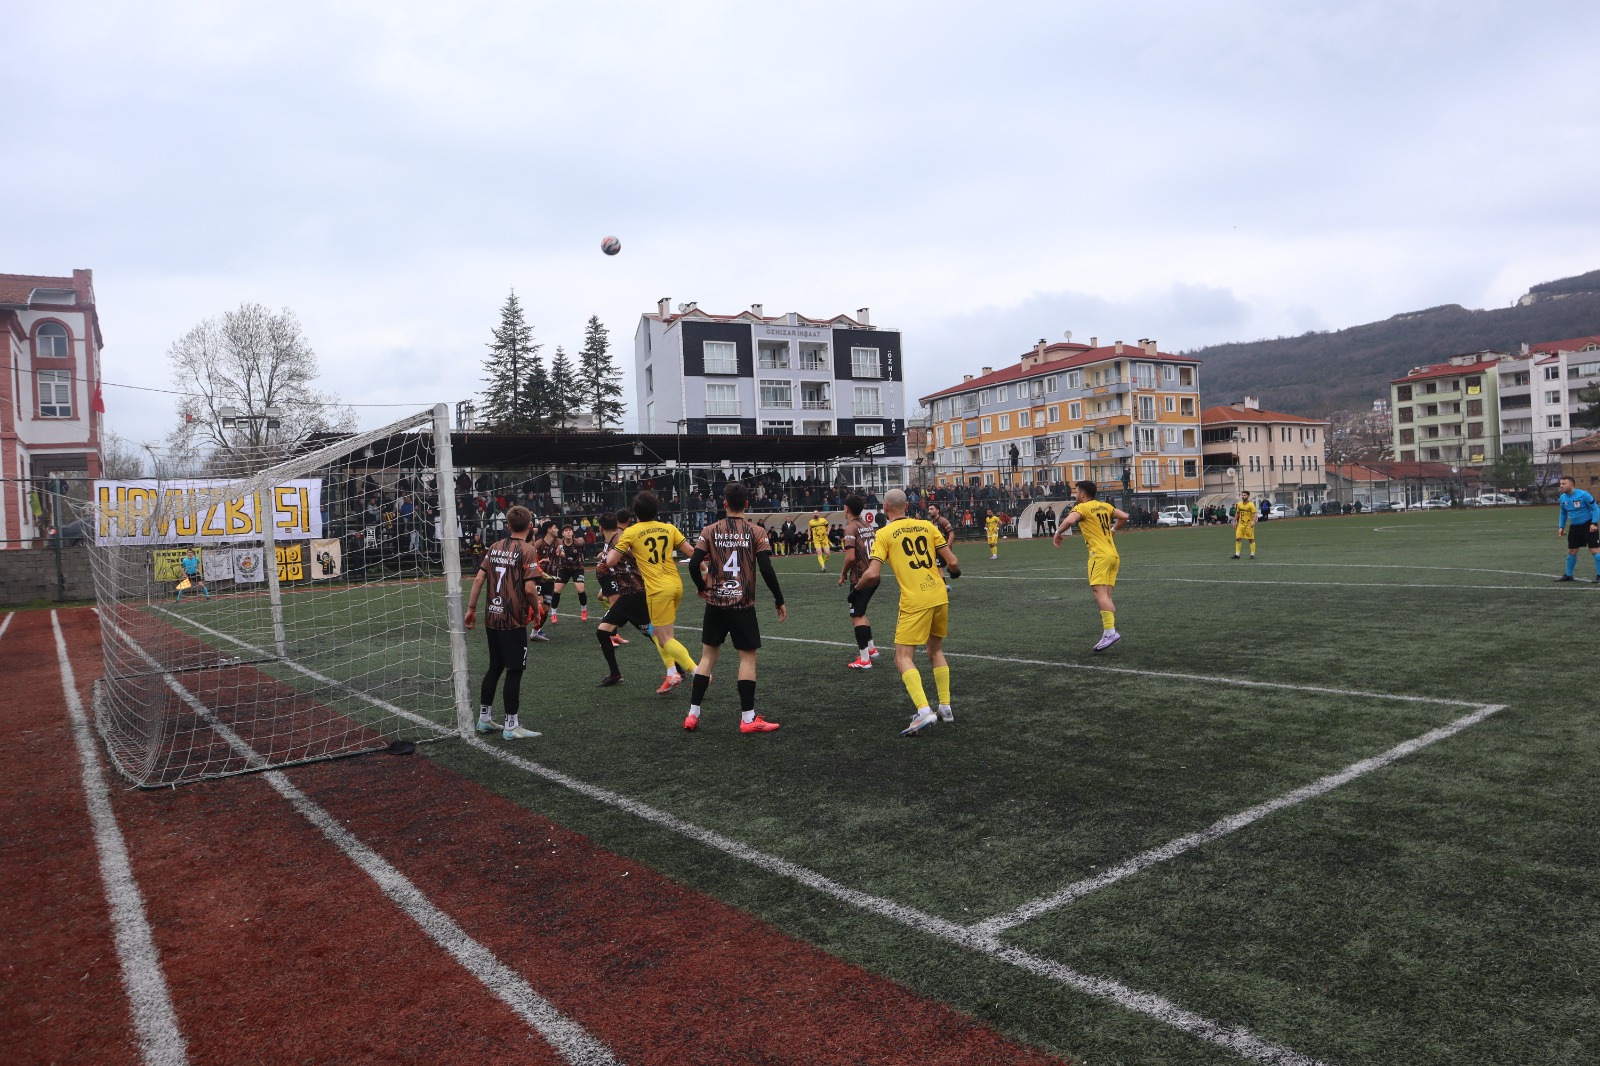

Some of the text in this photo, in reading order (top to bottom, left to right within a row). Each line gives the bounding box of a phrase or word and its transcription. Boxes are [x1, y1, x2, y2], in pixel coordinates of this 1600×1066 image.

[643, 535, 669, 565] 37
[722, 550, 741, 577] 4
[901, 535, 933, 570] 99
[495, 566, 507, 593] 7
